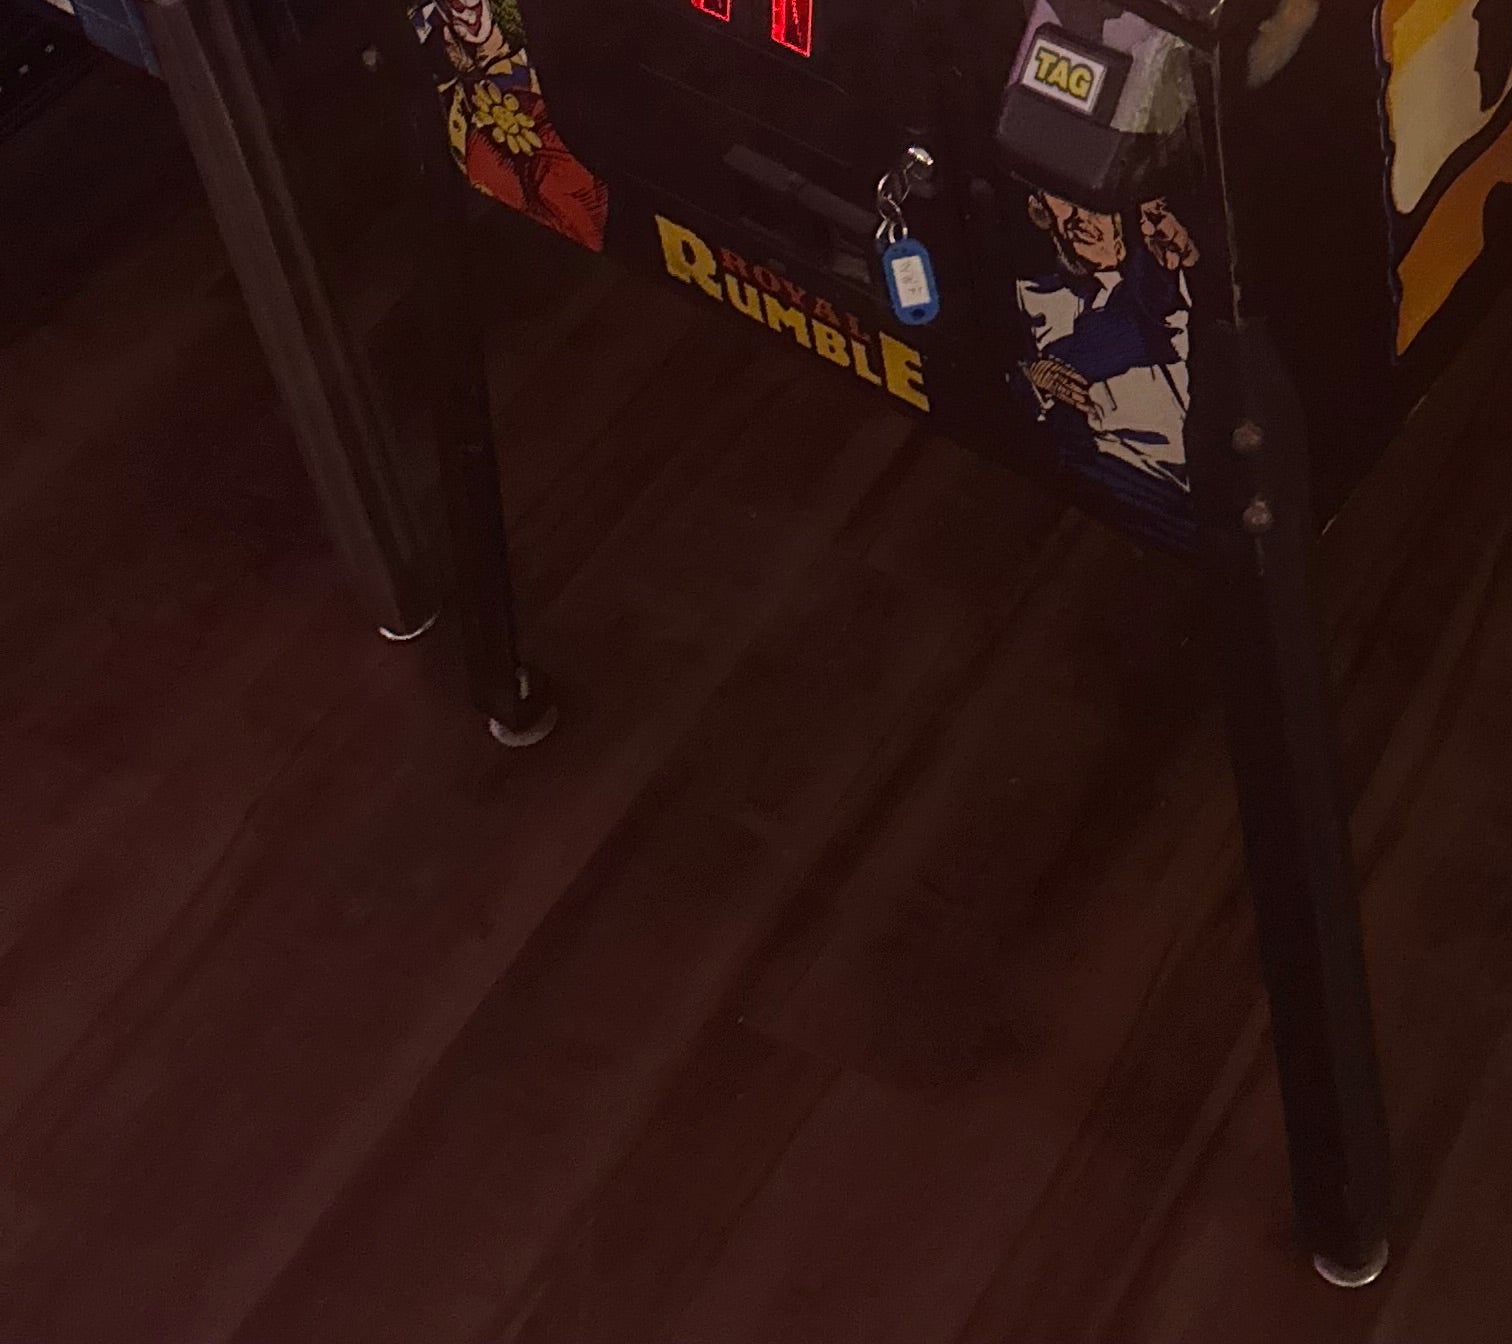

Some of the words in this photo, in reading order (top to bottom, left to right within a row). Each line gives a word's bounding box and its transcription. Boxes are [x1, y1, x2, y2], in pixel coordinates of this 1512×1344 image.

[1034, 49, 1095, 102] TAG
[654, 214, 930, 413] RUMBLE
[719, 247, 870, 342] ROYAL
